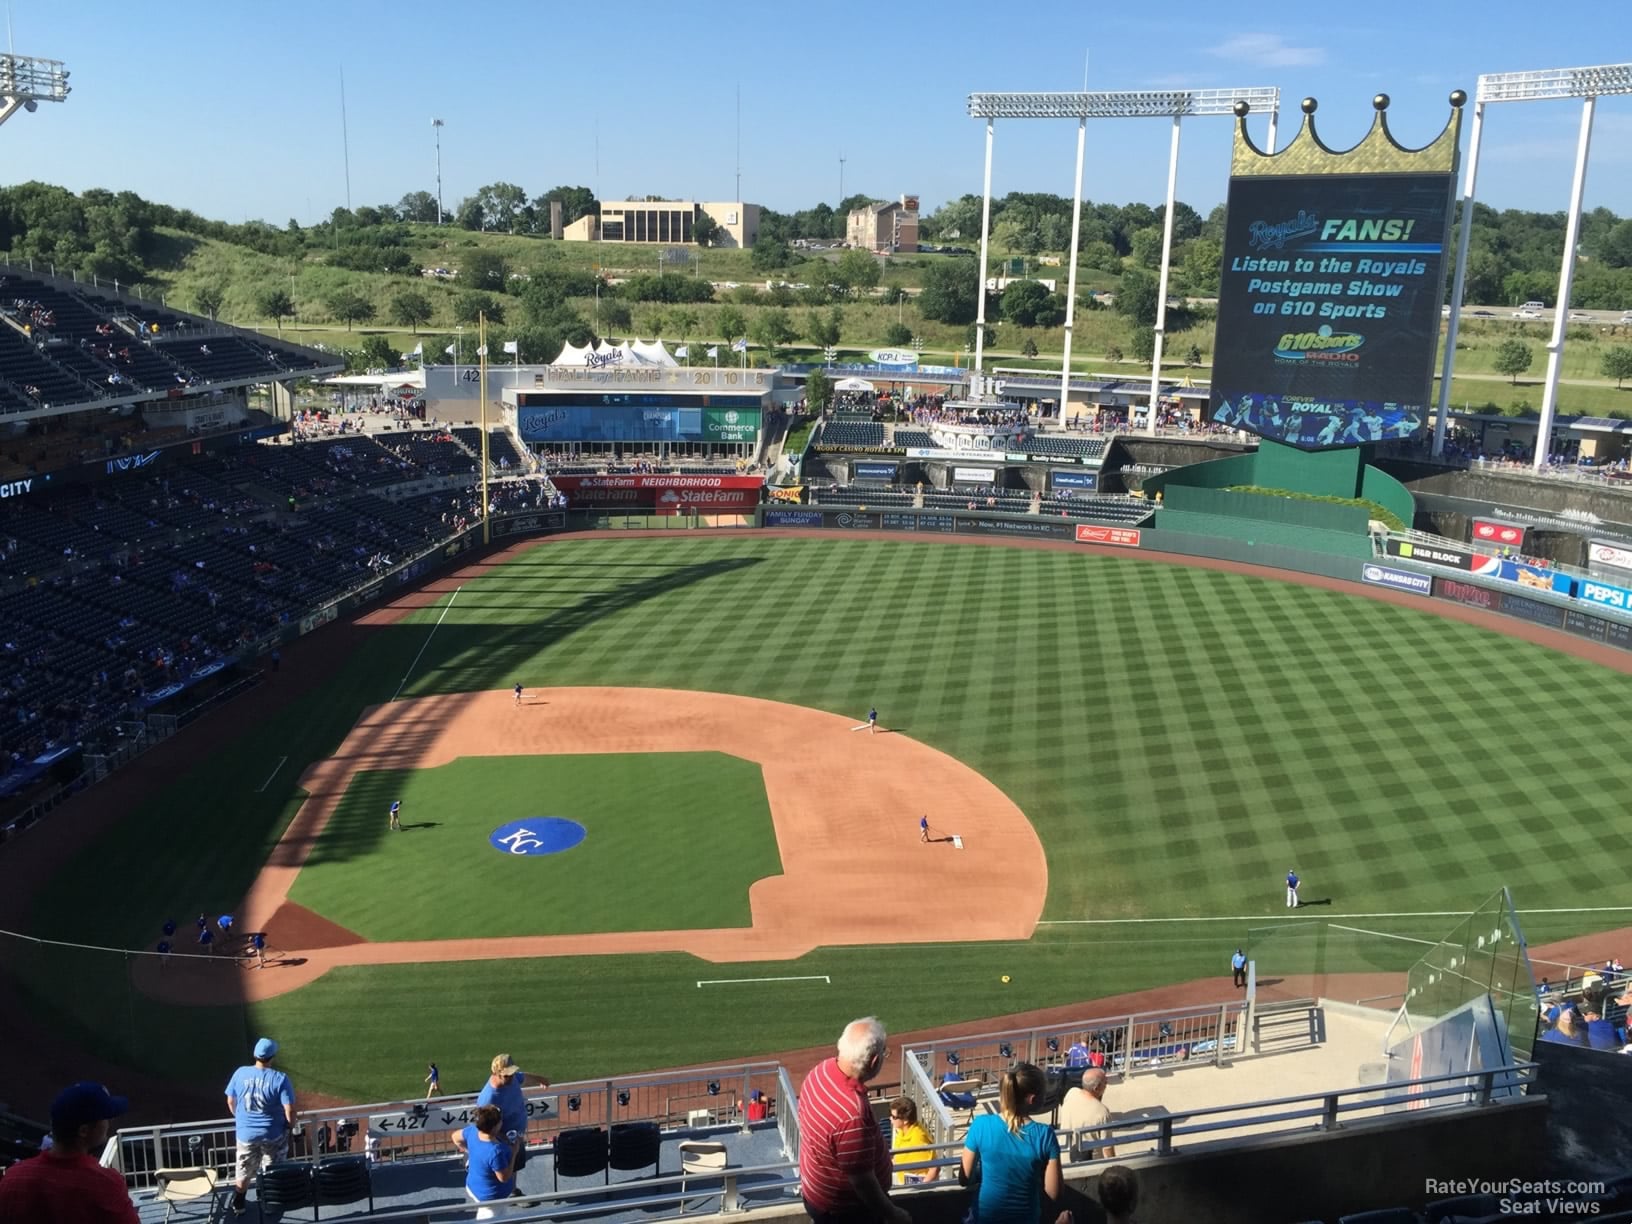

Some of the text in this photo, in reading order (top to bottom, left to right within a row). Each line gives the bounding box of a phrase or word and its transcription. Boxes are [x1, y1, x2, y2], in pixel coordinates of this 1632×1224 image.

[1249, 210, 1415, 250] Royals FANS!
[1231, 256, 1426, 277] Listen to the Royals
[1248, 279, 1403, 296] Postgame Show
[1253, 301, 1387, 319] on 610 Sports
[584, 348, 624, 368] Royals
[1305, 352, 1359, 361] RADIO
[463, 370, 480, 382] 42
[548, 368, 591, 383] HALL
[613, 369, 661, 383] FAME
[695, 372, 764, 384] 20 10 5
[1291, 403, 1333, 414] ROYAL
[523, 408, 569, 433] Royals
[708, 423, 755, 432] Commerce
[721, 432, 743, 440] Bank
[1, 479, 32, 498] CITY
[641, 478, 721, 487] NEIGHBORHOOD
[769, 489, 800, 498] SONIC
[1003, 522, 1033, 530] Network
[1413, 548, 1462, 564] H&R BLOCK
[1383, 572, 1412, 585] KANSAS
[1412, 580, 1429, 589] CITY
[1584, 583, 1625, 606] PEPSI
[396, 1114, 429, 1131] 427
[459, 1108, 479, 1124] 42
